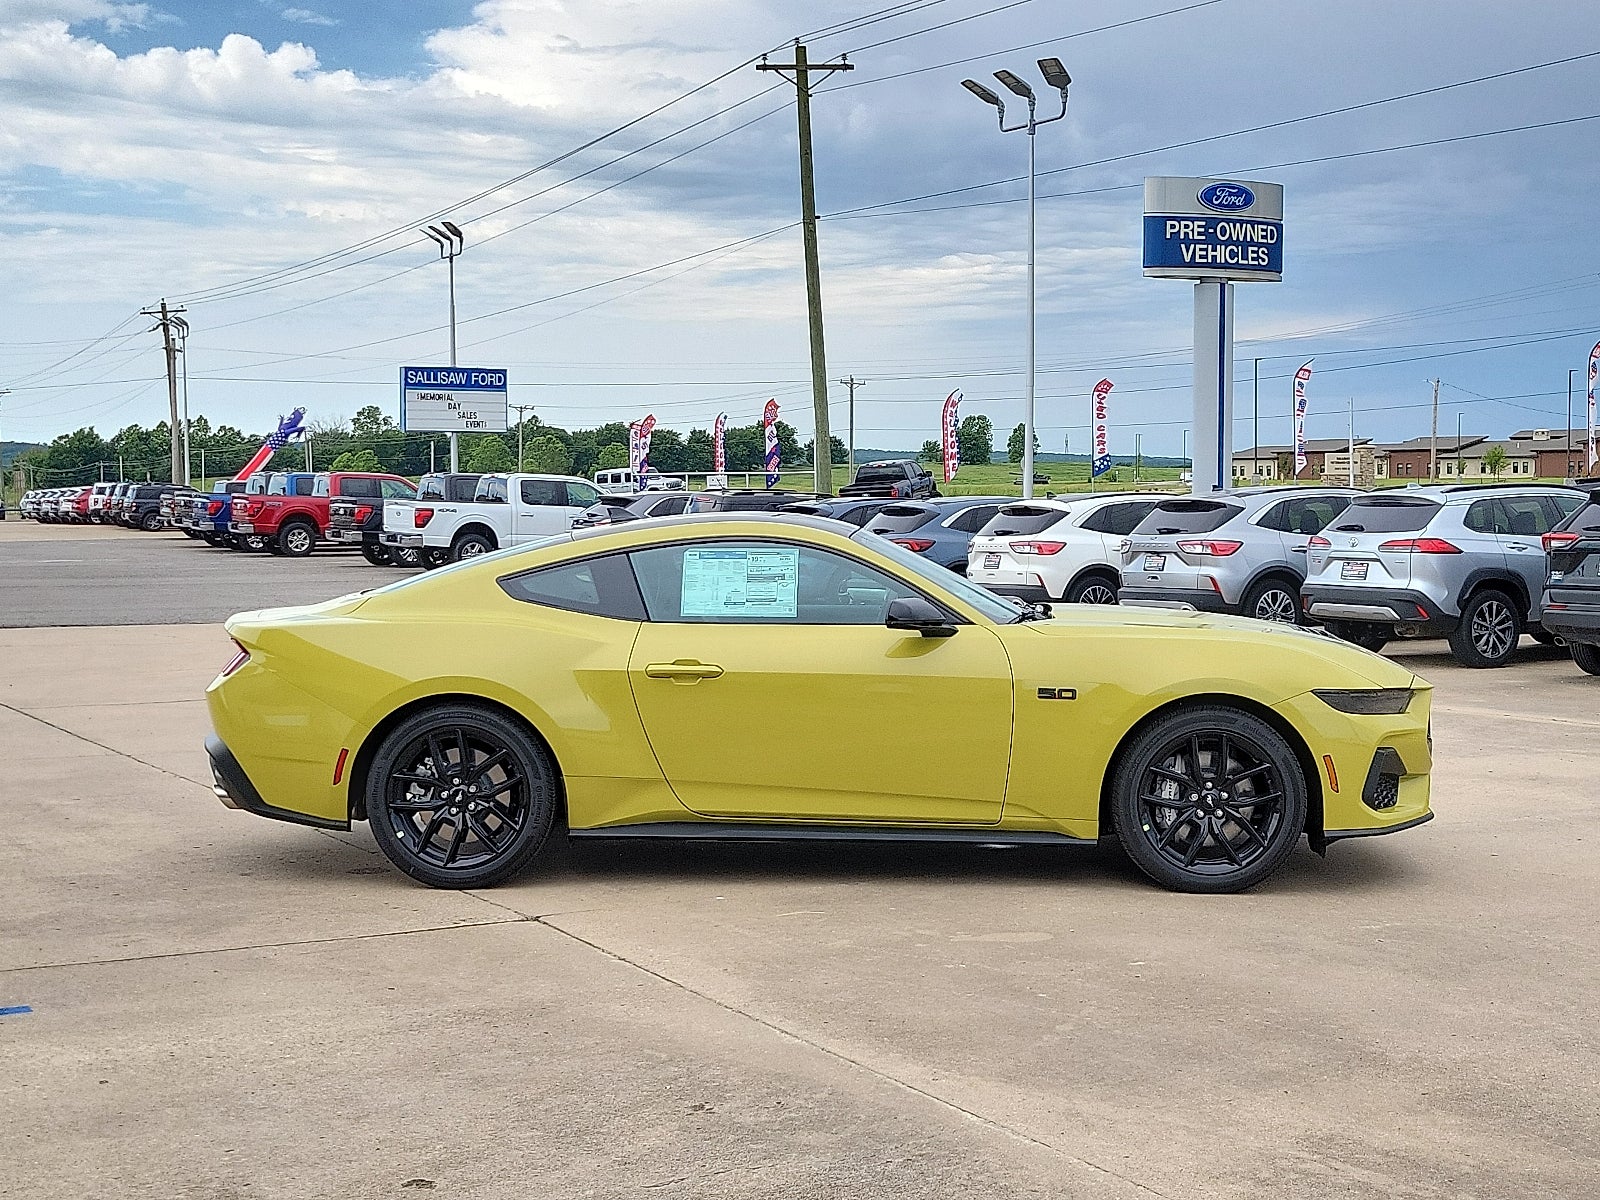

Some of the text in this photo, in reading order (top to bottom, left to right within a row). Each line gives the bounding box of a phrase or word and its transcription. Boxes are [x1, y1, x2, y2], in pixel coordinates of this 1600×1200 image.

[1212, 187, 1246, 207] Ford
[1180, 243, 1269, 266] VEHICLES
[407, 370, 505, 386] SALLISAW FORD
[447, 402, 461, 410] DAY
[457, 411, 478, 420] SALES
[948, 398, 958, 472] WELCOME
[1096, 424, 1107, 455] CARS
